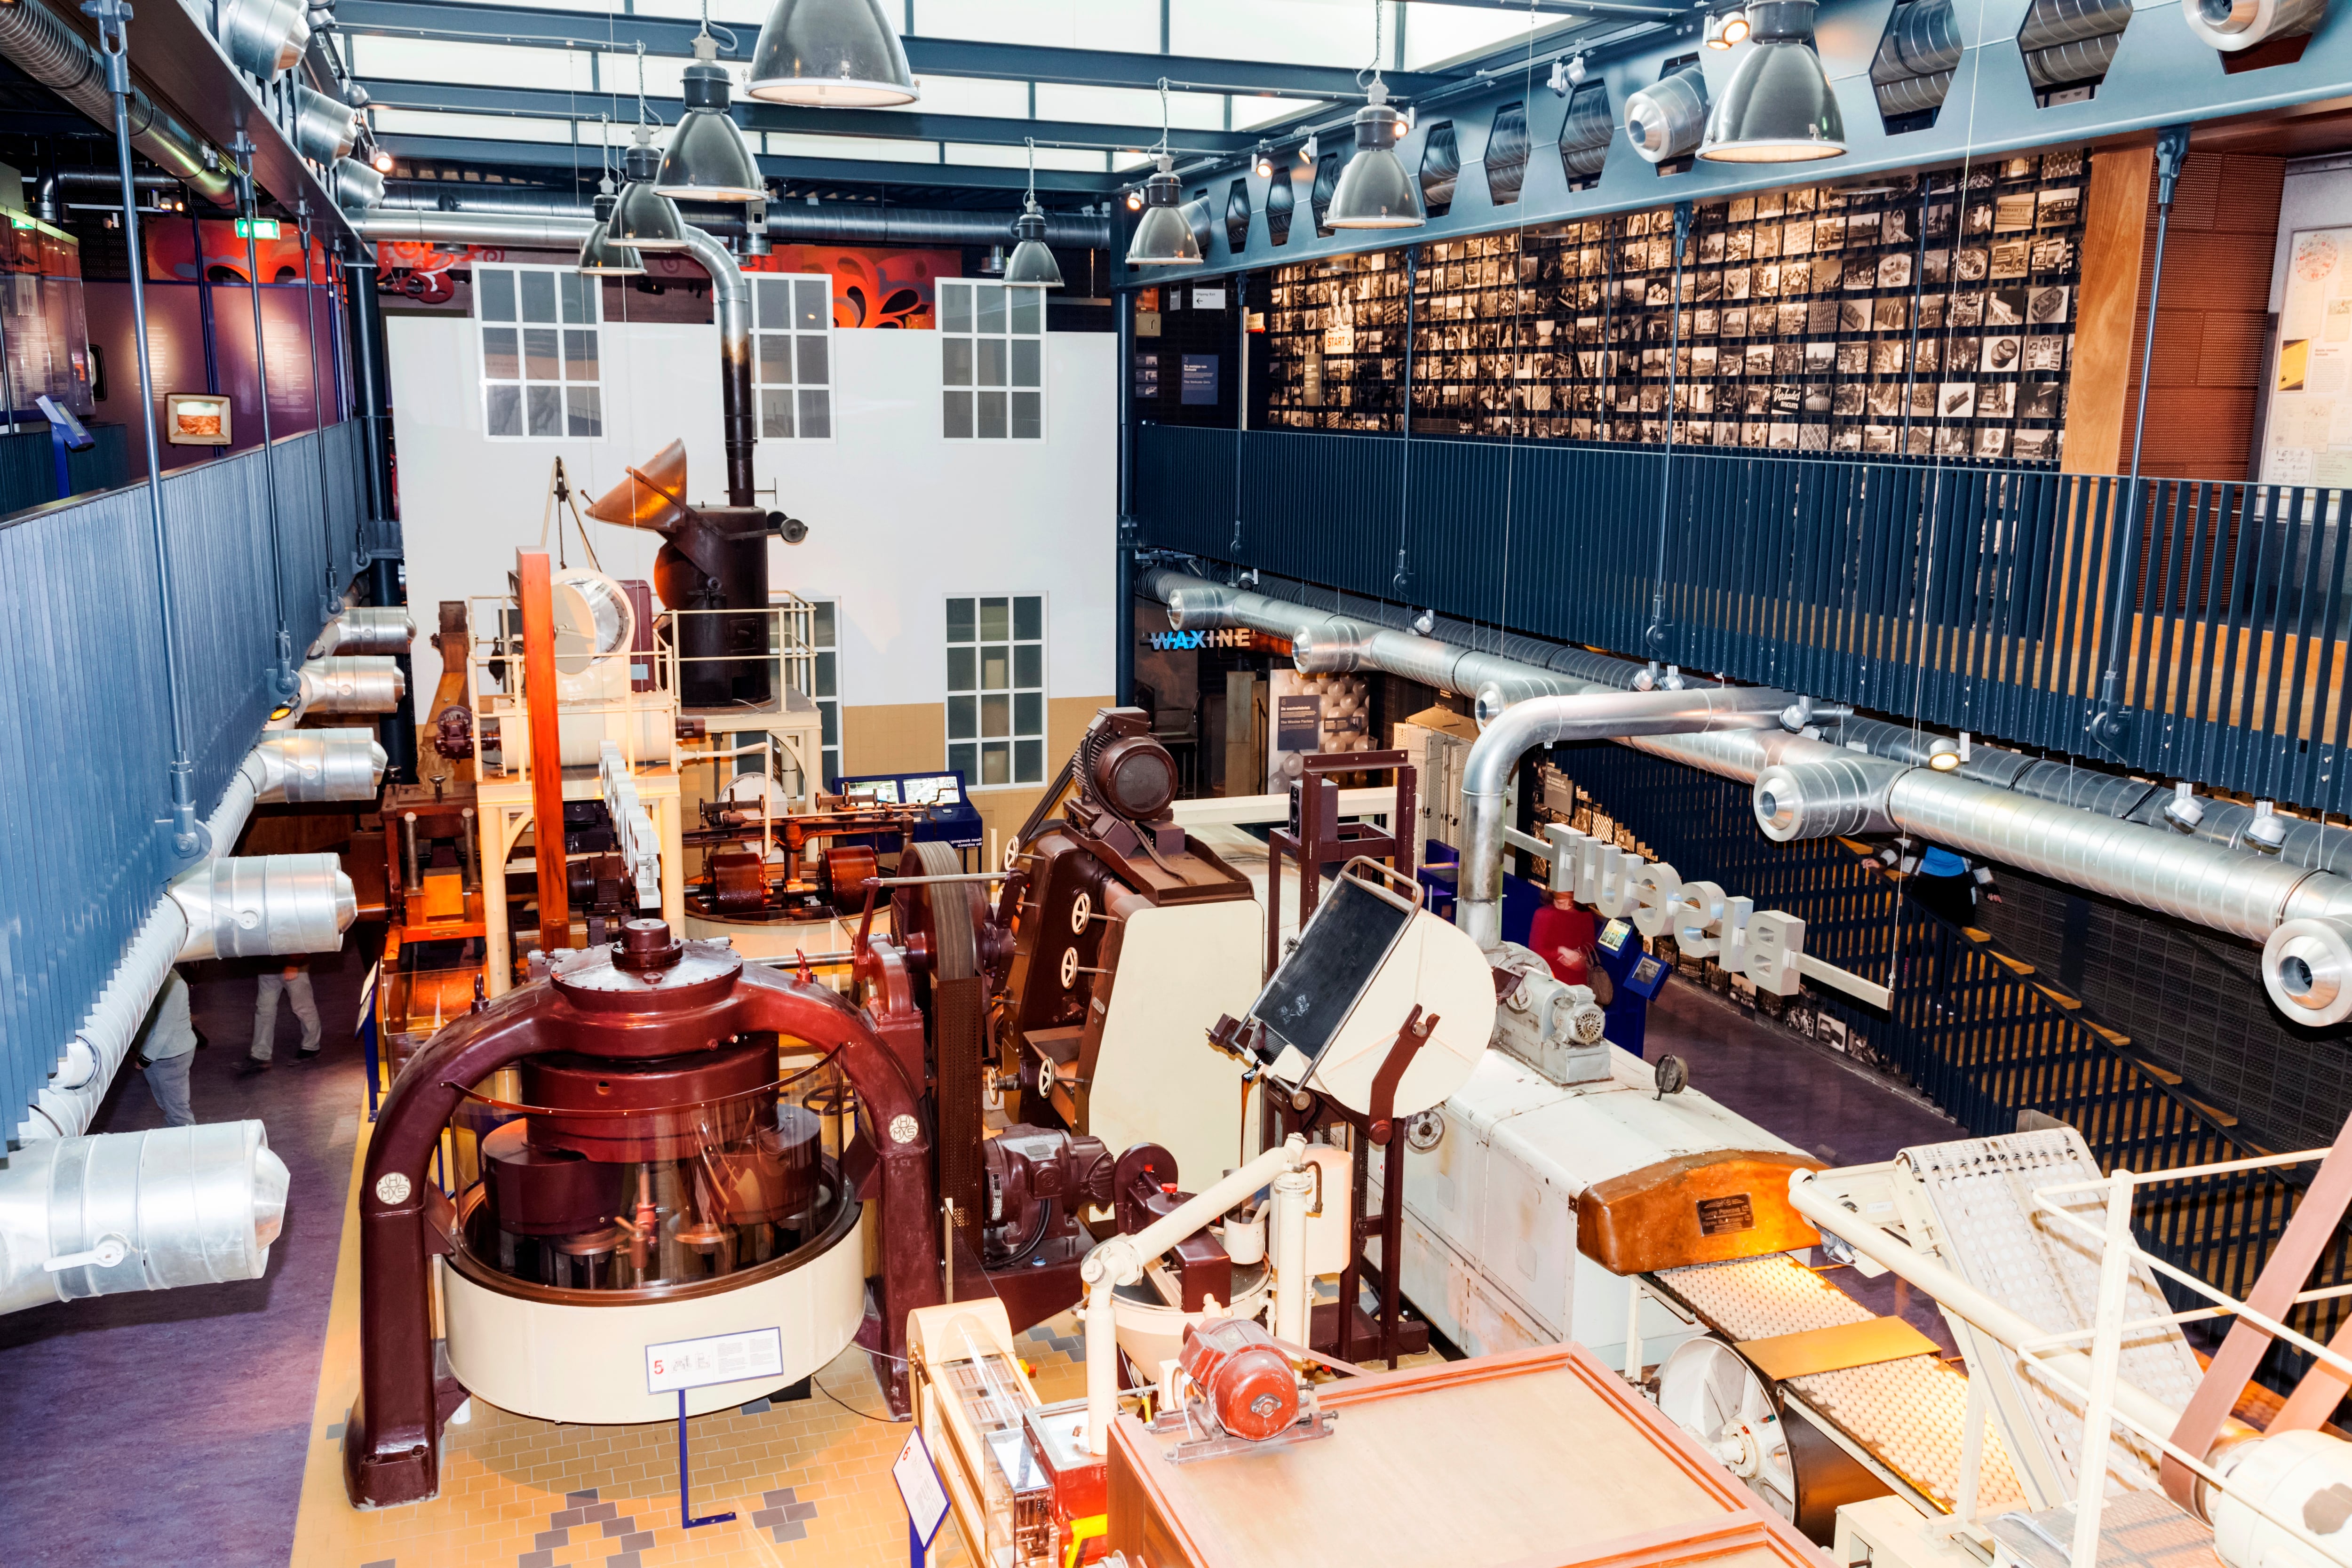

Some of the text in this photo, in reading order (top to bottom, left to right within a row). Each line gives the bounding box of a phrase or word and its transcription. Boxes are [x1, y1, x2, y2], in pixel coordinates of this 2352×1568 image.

[1327, 336, 1345, 347] START
[1780, 401, 1798, 409] BISCUITS
[1150, 628, 1251, 650] WAXINE
[654, 1360, 664, 1375] 5
